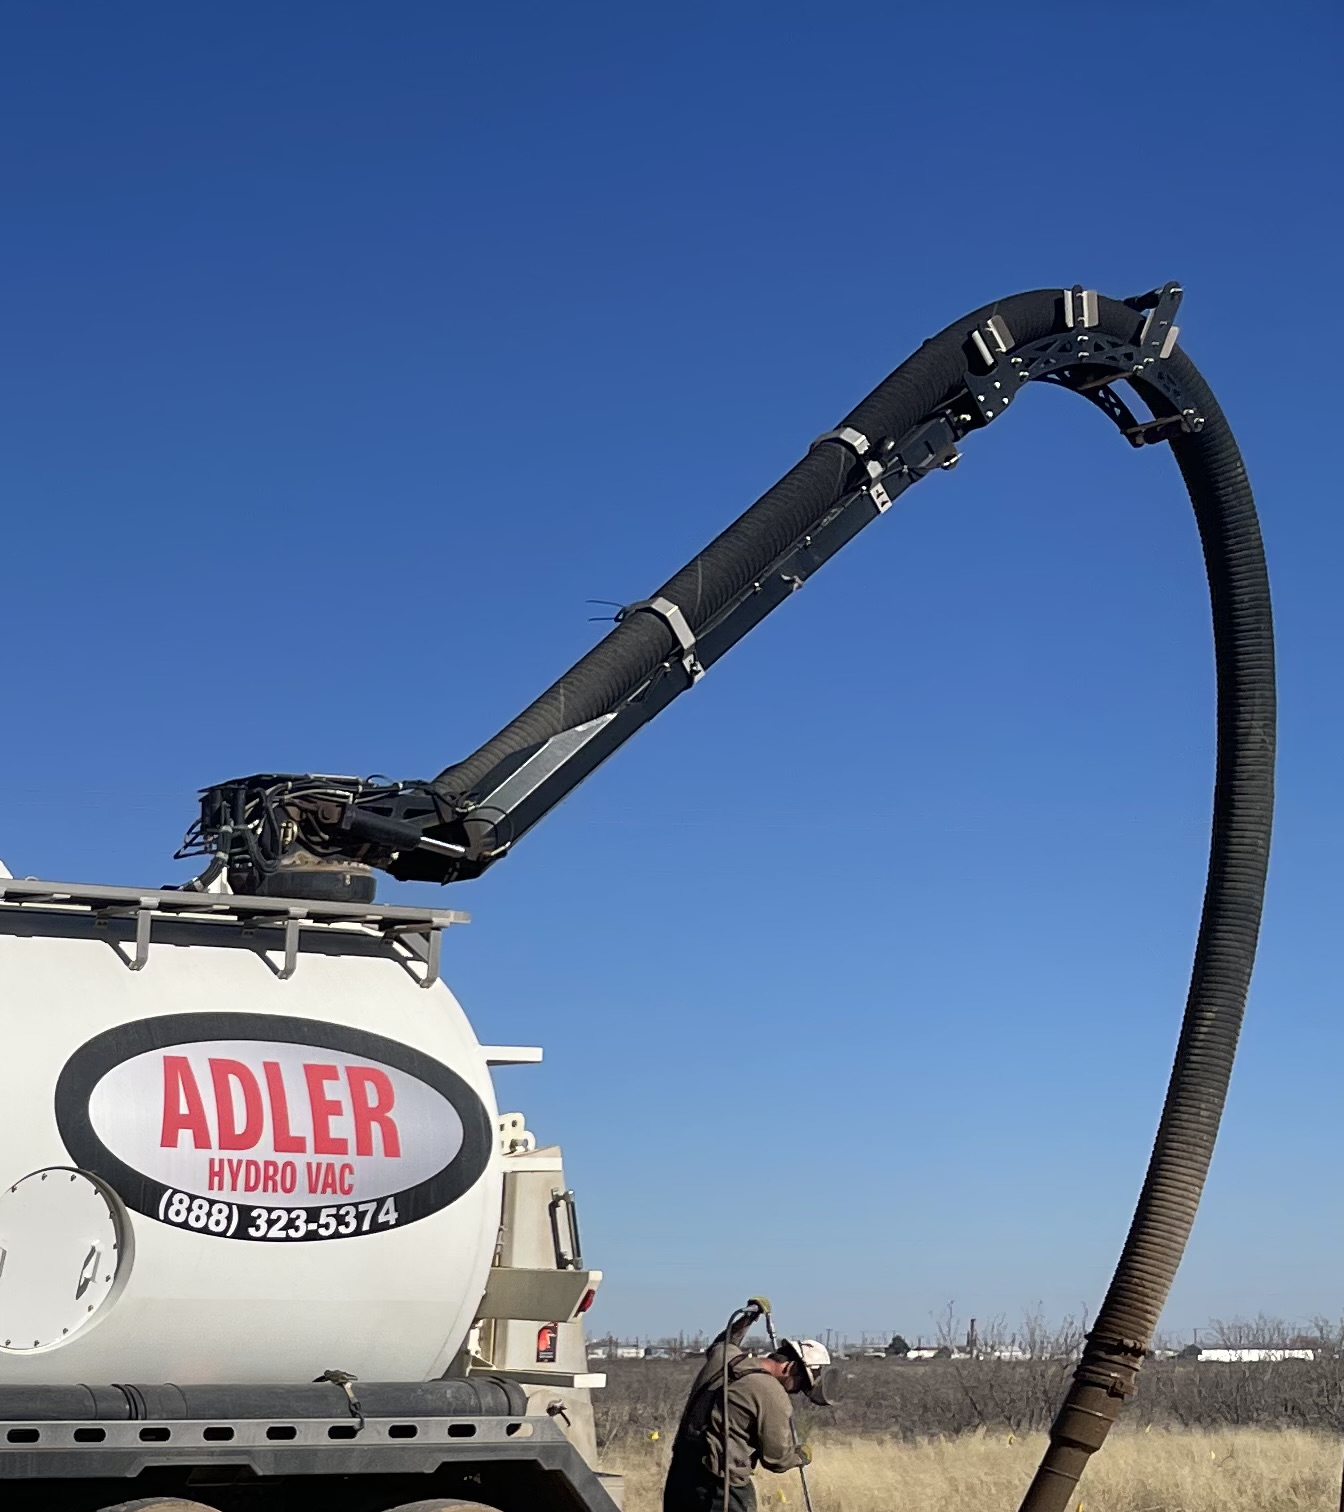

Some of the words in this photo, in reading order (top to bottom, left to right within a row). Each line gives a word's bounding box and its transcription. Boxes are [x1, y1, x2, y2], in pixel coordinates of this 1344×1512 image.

[160, 1055, 401, 1158] ADLER
[207, 1157, 297, 1194] HYDRO
[306, 1161, 355, 1196] VAC
[158, 1188, 239, 1237] (888)
[247, 1196, 399, 1239] 323-5374
